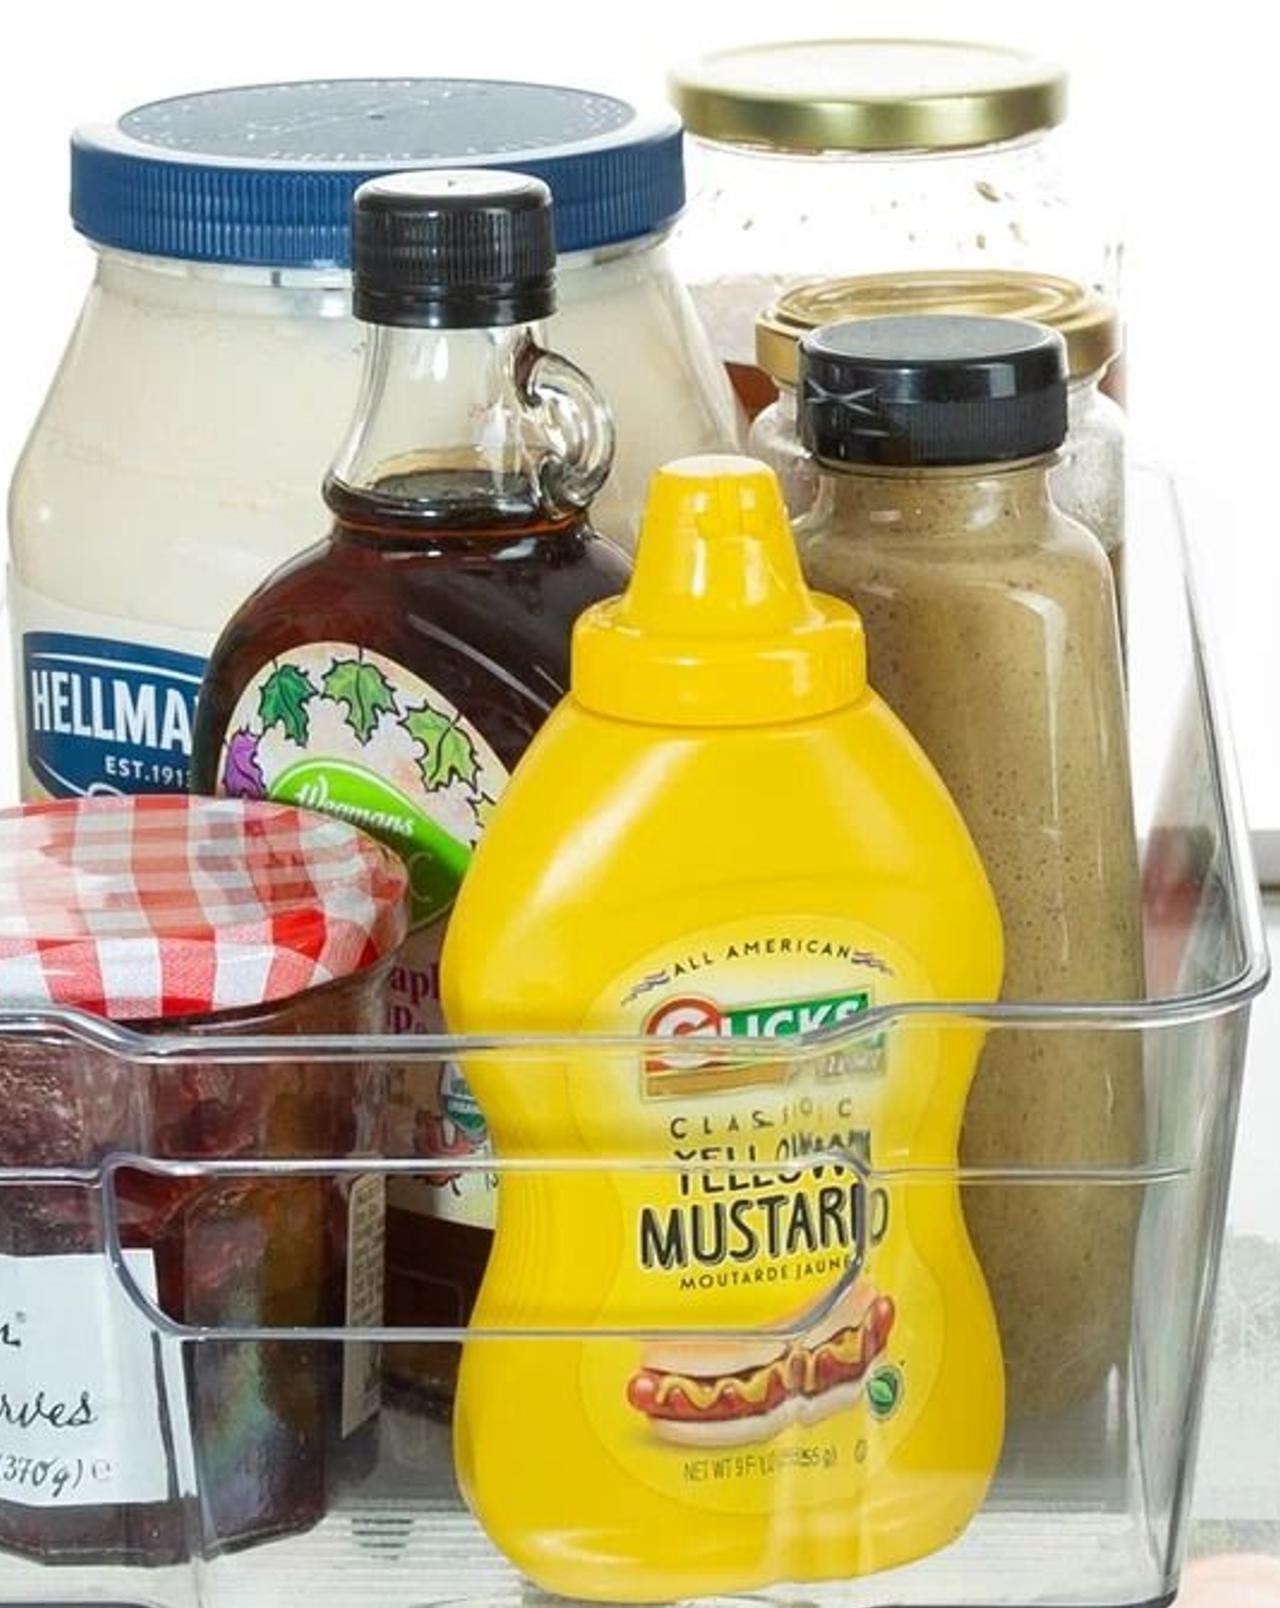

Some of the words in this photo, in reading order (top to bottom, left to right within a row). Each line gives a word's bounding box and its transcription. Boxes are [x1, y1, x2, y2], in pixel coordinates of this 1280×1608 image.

[31, 669, 200, 756] HELLMA
[672, 954, 713, 977] ALL
[726, 938, 851, 962] AMERICAN
[389, 963, 439, 1005] apl
[680, 1266, 789, 1291] MOUTARDE
